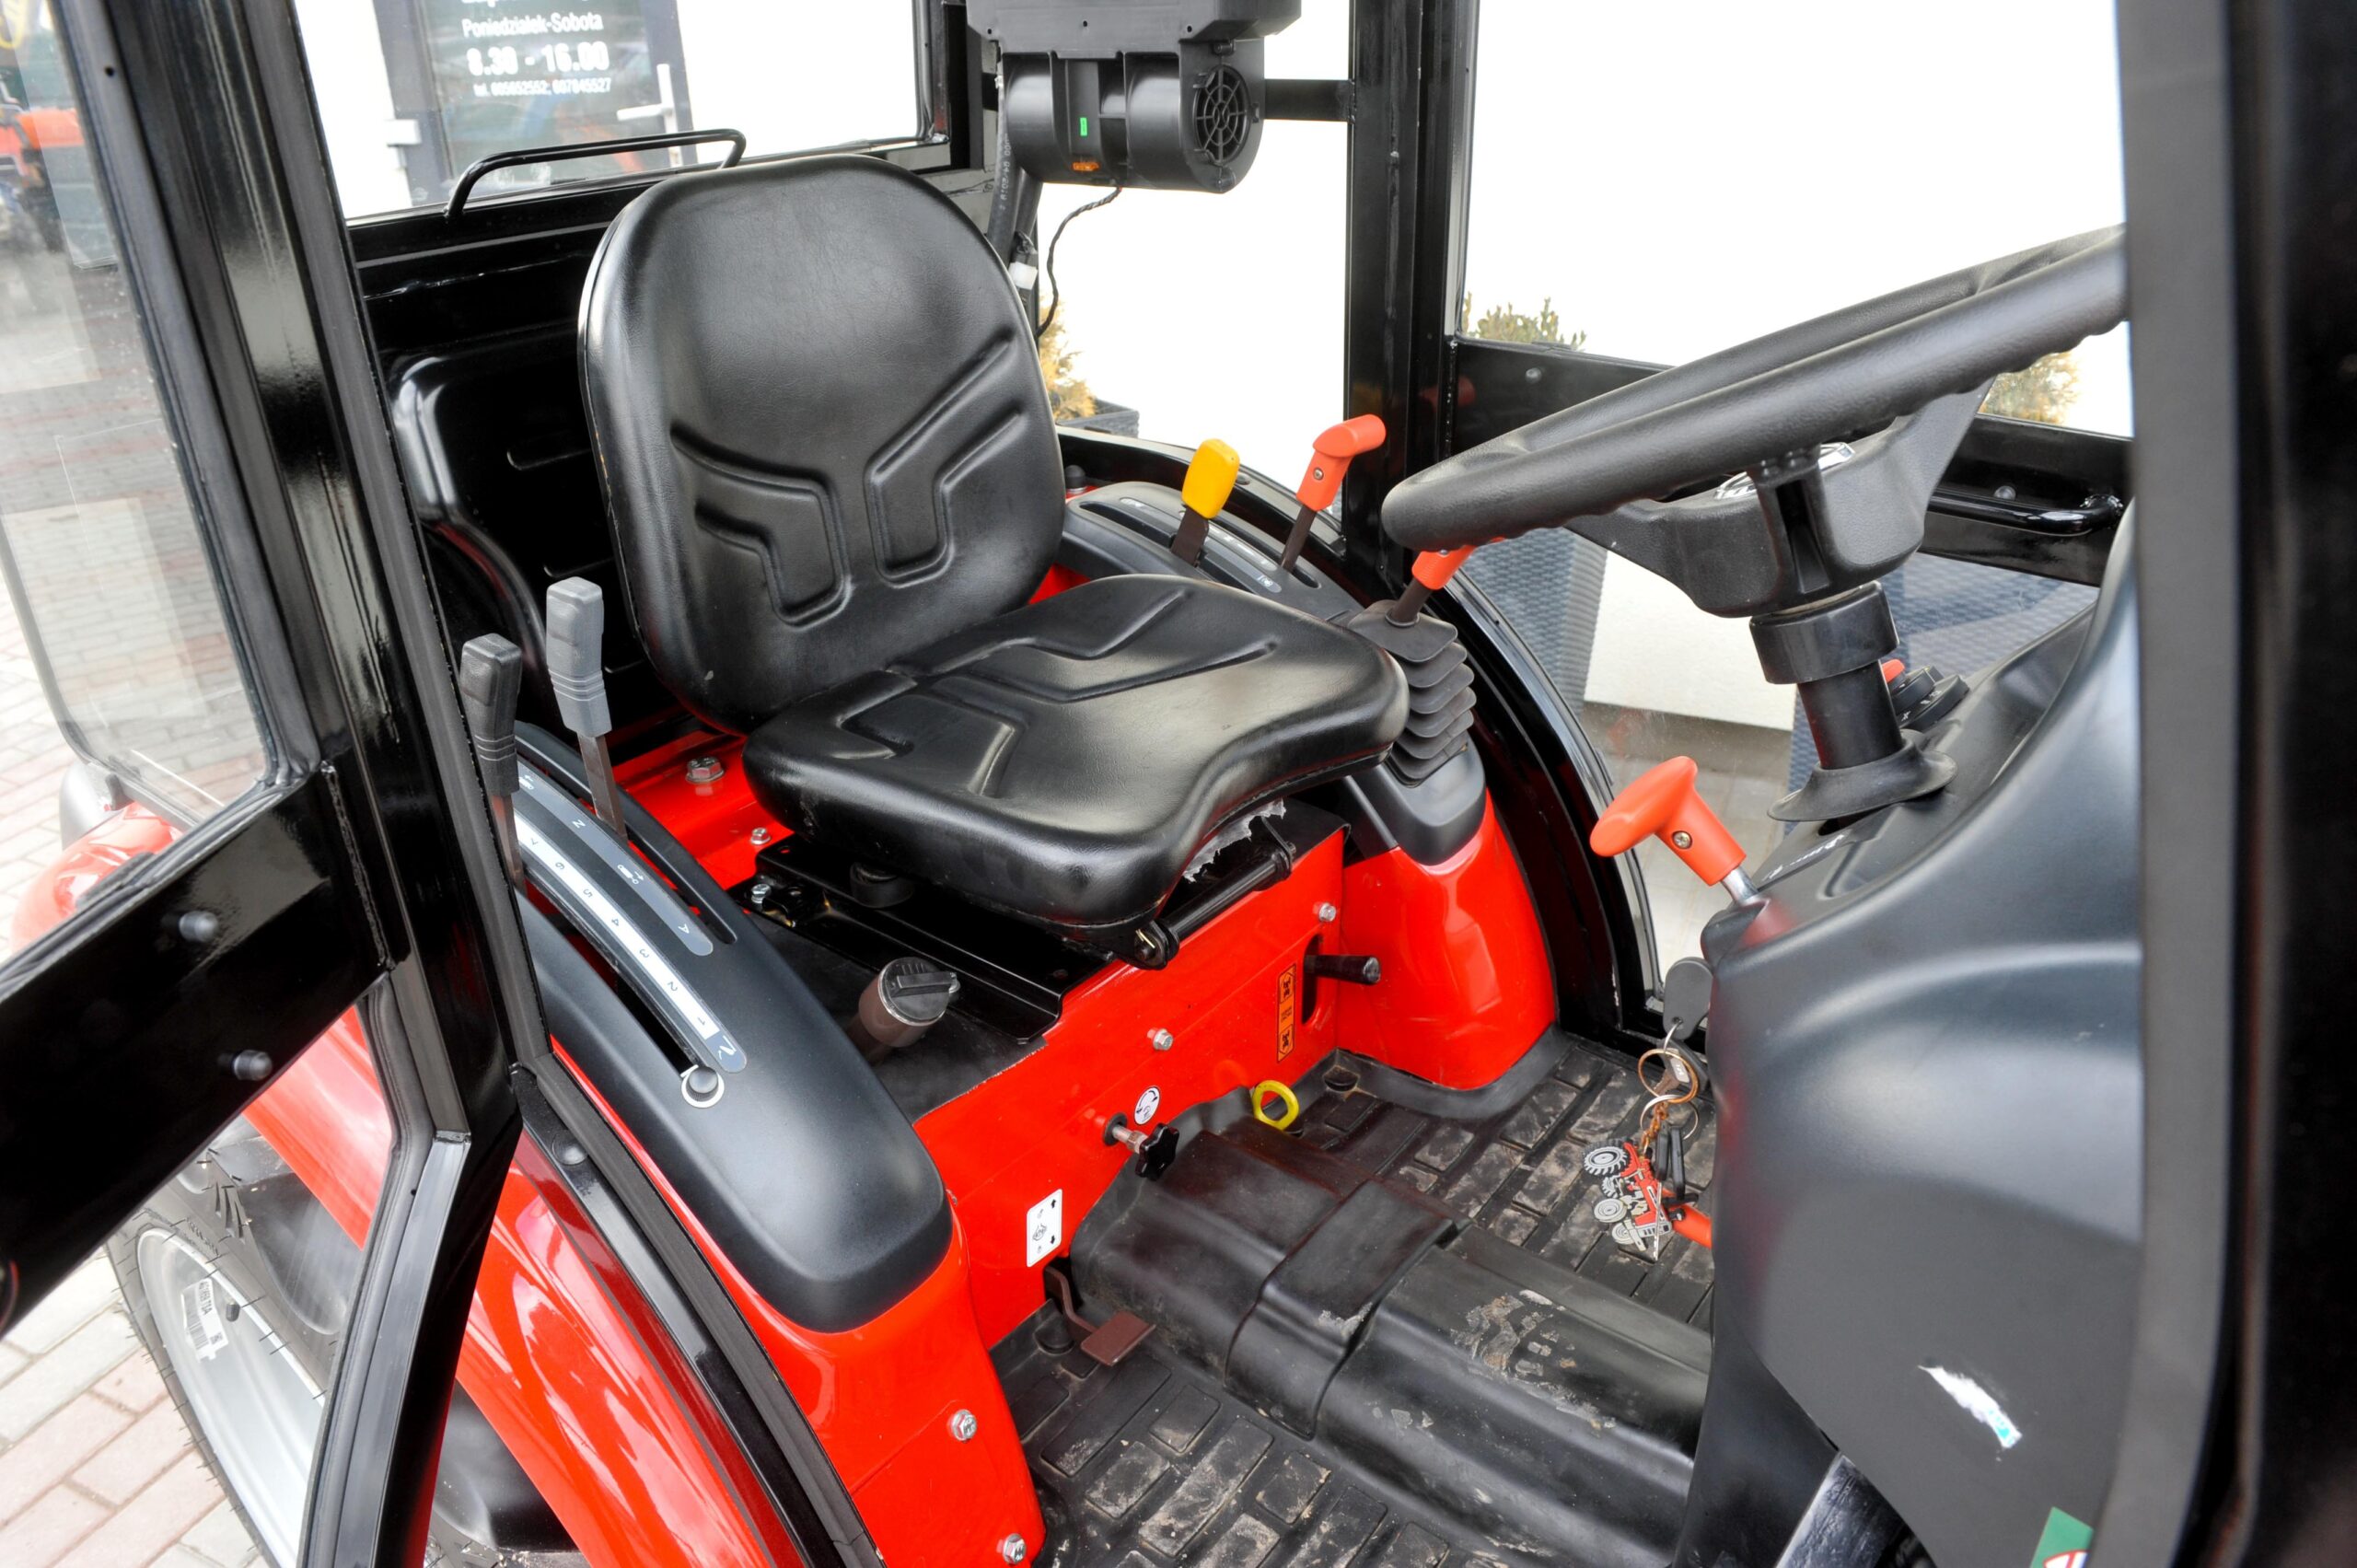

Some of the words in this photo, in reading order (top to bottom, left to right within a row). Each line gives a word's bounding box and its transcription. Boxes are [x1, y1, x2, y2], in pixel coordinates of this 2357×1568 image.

[466, 46, 518, 75] 8.30
[541, 41, 610, 73] 16.00
[572, 819, 586, 829] N
[530, 837, 539, 846] 7
[555, 862, 565, 870] 6
[583, 889, 593, 898] 5
[611, 918, 620, 927] 4
[678, 923, 690, 934] A
[639, 948, 649, 958] 3
[667, 981, 679, 992] 2
[697, 1016, 706, 1026] 1
